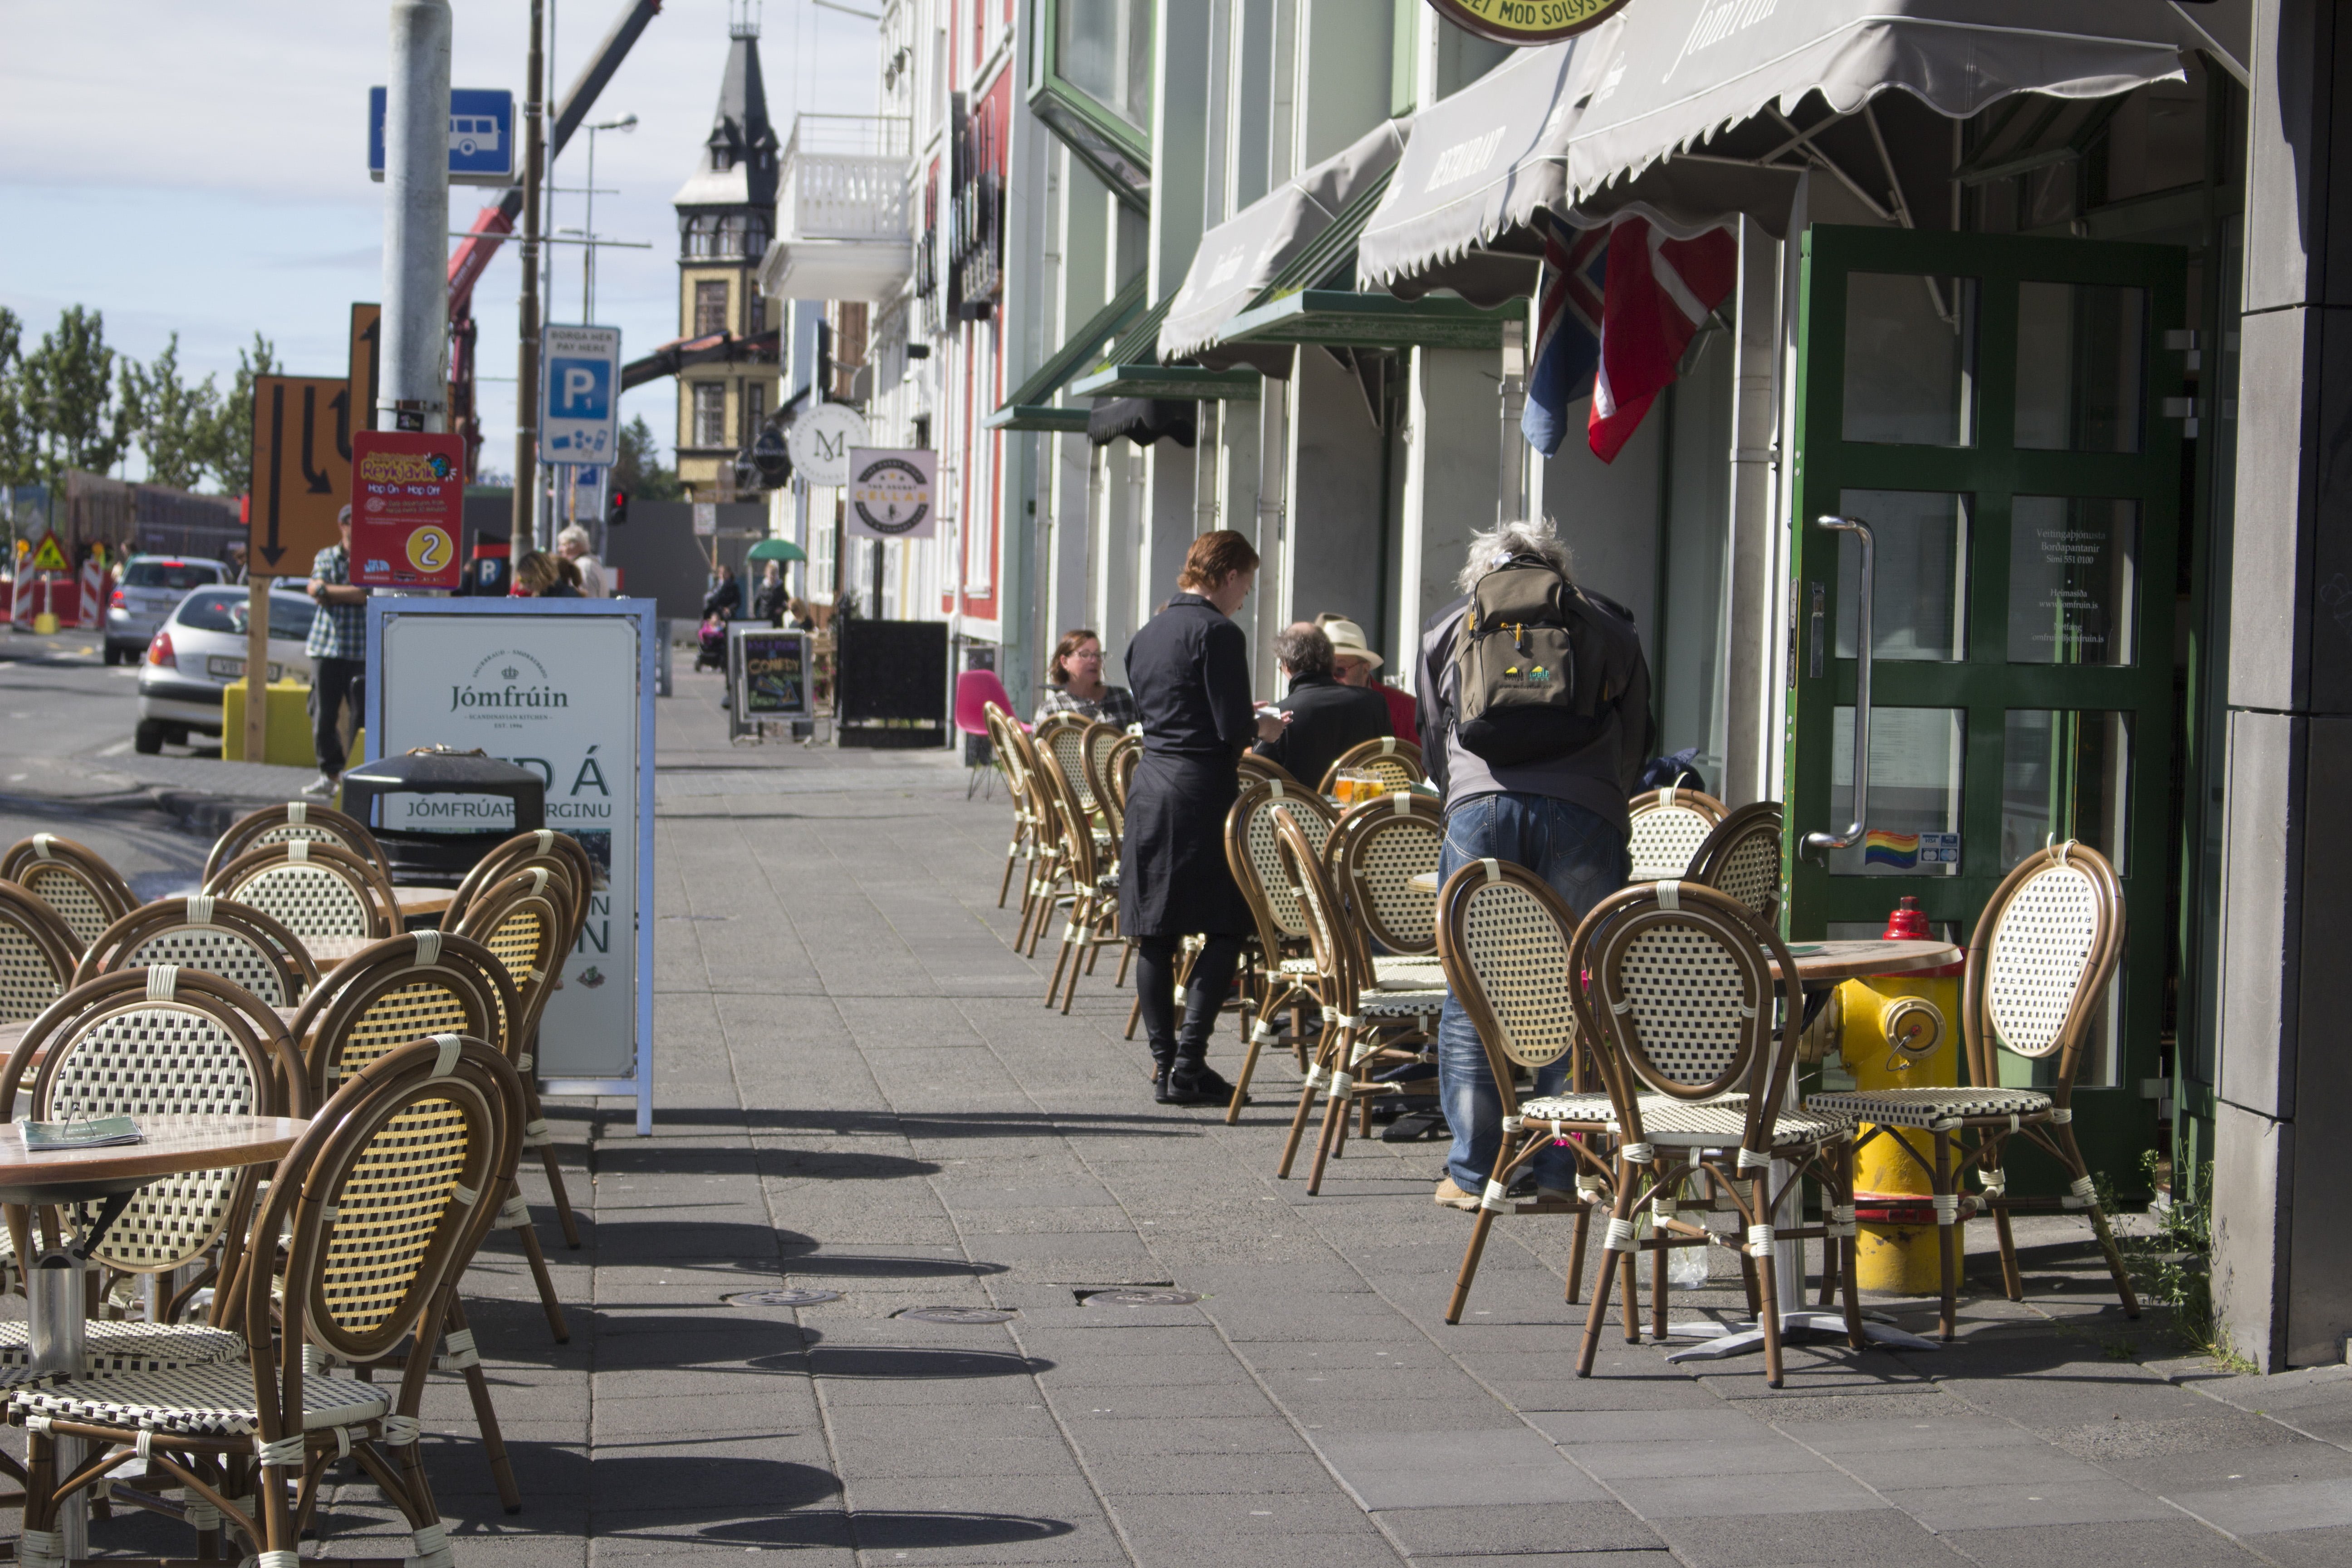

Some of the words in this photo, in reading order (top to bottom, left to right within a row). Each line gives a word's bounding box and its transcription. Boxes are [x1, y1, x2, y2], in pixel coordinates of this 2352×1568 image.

[1499, 1, 1536, 24] MOD
[1542, 0, 1597, 25] SOLLYS
[1424, 125, 1506, 194] RESTAURANT
[556, 341, 574, 351] PAY
[578, 343, 606, 353] HERE
[564, 368, 596, 409] P
[814, 429, 845, 462] M
[368, 483, 385, 495] Hop
[387, 483, 400, 494] On
[408, 485, 425, 495] Hop
[426, 485, 441, 495] Off
[856, 490, 927, 501] CELLAR
[2036, 528, 2106, 541] Veitingaþjónusta
[420, 533, 441, 566] 2
[2042, 542, 2100, 554] Borðapantanir
[2064, 555, 2075, 563] 551
[2078, 556, 2094, 564] 0100
[2050, 588, 2087, 598] Heimasíða
[2039, 600, 2098, 609] wwwomfruin.is
[450, 685, 569, 712] Jómfrúin
[570, 744, 612, 797] Á
[407, 798, 612, 818] JÓMFRÚARRGINU
